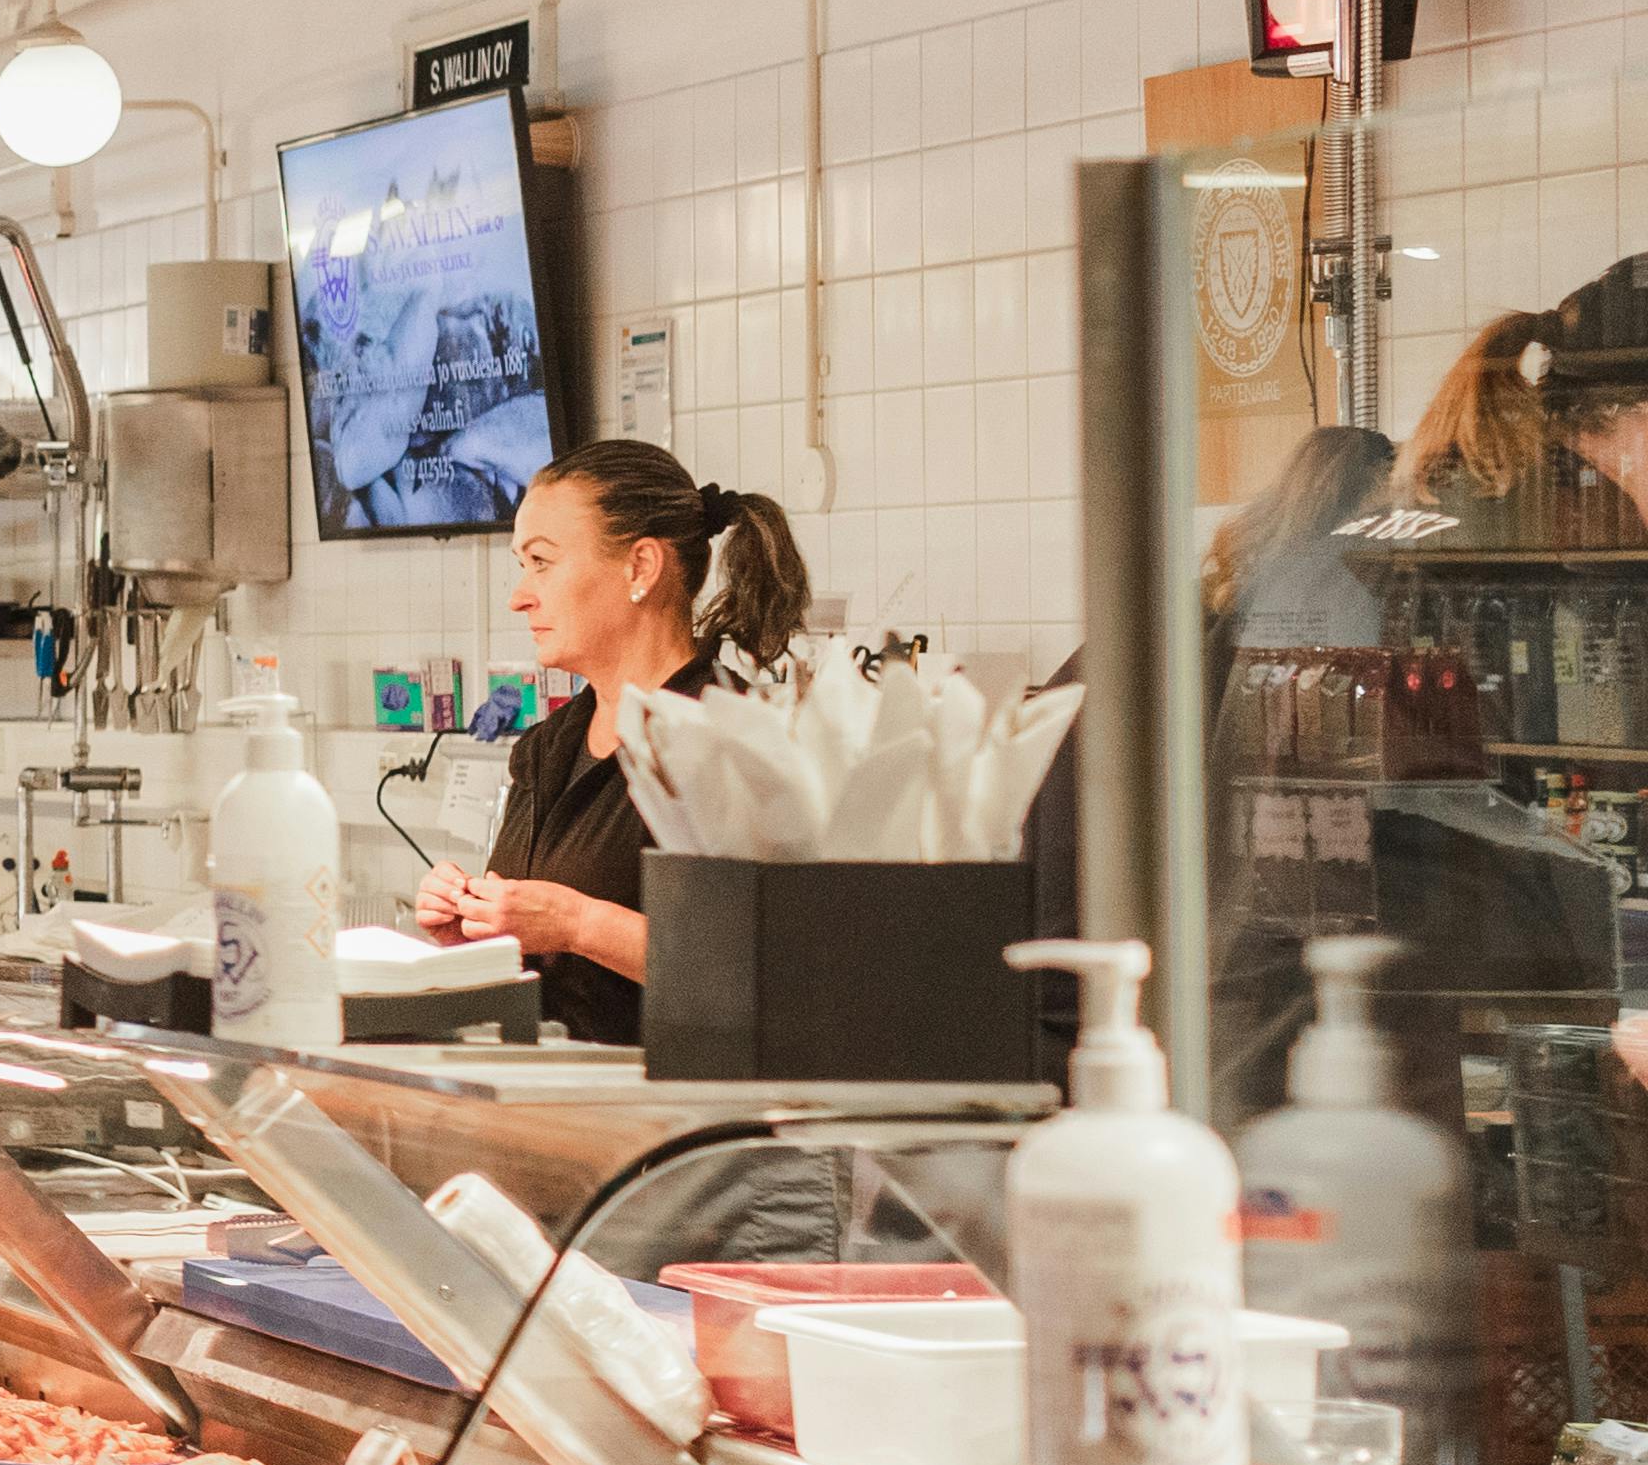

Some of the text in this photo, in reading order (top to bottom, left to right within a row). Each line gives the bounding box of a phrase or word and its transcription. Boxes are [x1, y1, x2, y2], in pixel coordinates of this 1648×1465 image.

[430, 39, 514, 94] S. WALLIN OY
[436, 357, 450, 390] jo
[451, 350, 503, 382] vuodesta
[504, 346, 529, 381] 1887
[1209, 380, 1281, 405] PARTENAIRE
